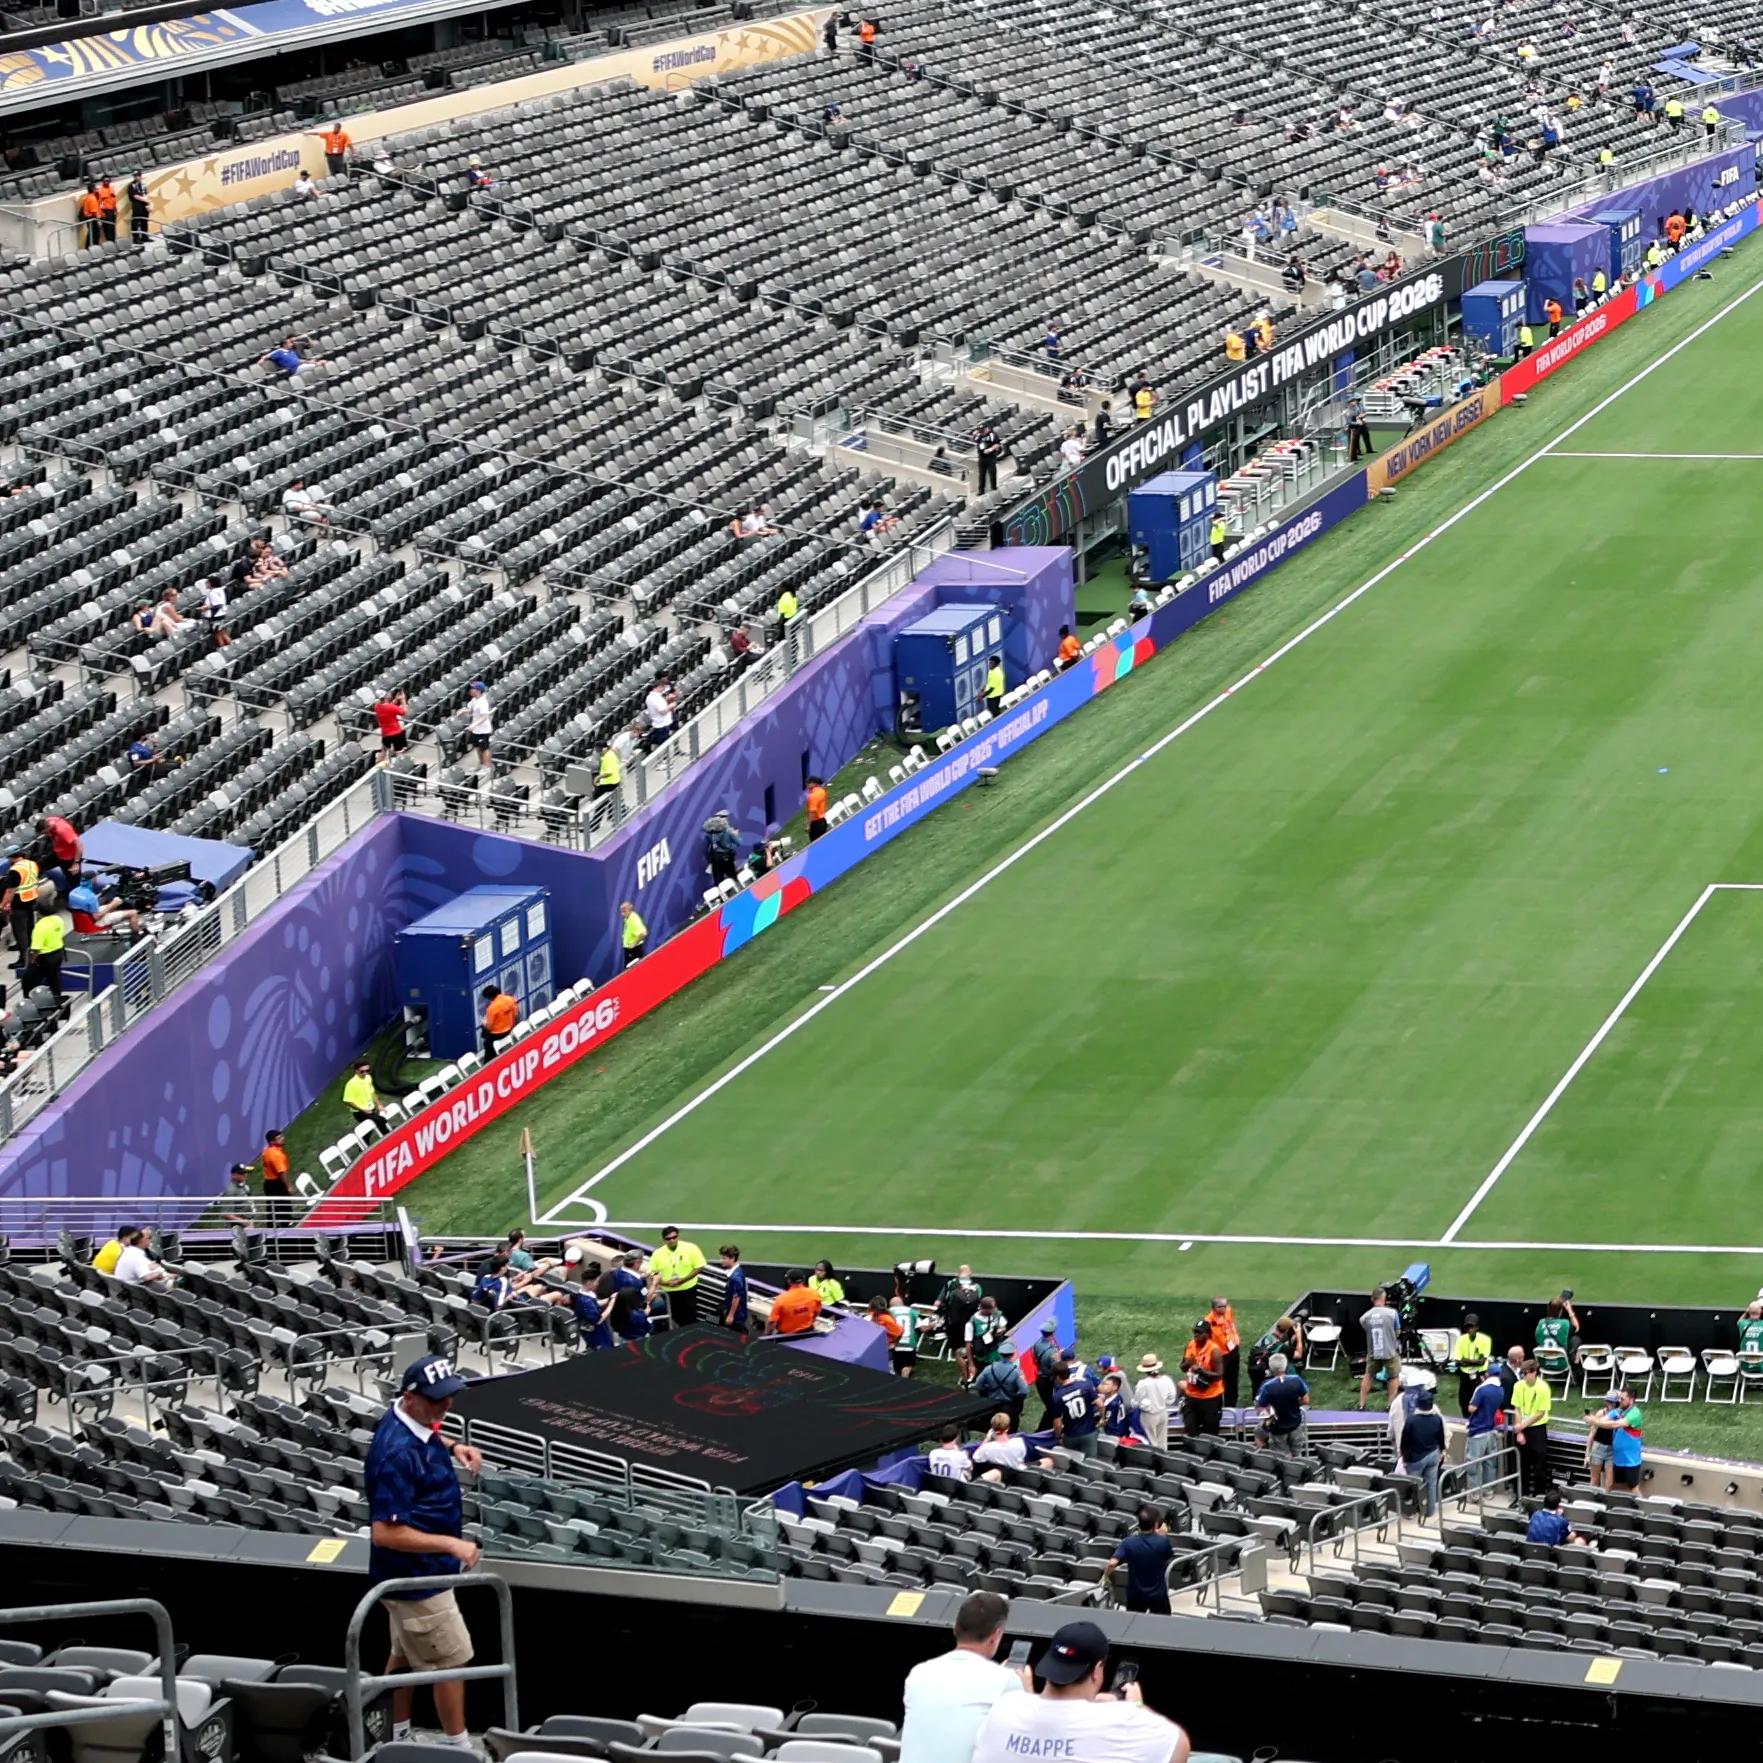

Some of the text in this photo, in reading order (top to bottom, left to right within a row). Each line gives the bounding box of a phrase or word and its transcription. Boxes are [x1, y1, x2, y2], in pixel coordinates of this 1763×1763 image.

[652, 45, 716, 73] #FIFAWorldCup
[1721, 166, 1740, 186] FIFA
[1105, 418, 1185, 491] OFFICIAL
[1187, 360, 1270, 438] PLAYLIST
[1272, 341, 1305, 387] FIFA
[1305, 313, 1356, 365] WORLD
[1357, 301, 1389, 337] CUP
[637, 837, 672, 890] FIFA
[363, 1142, 414, 1198] FIFA
[415, 1082, 494, 1159] WORLD
[496, 1050, 539, 1100] CUP
[1069, 1396, 1086, 1419] 10
[1006, 1734, 1075, 1757] MBAPPE
